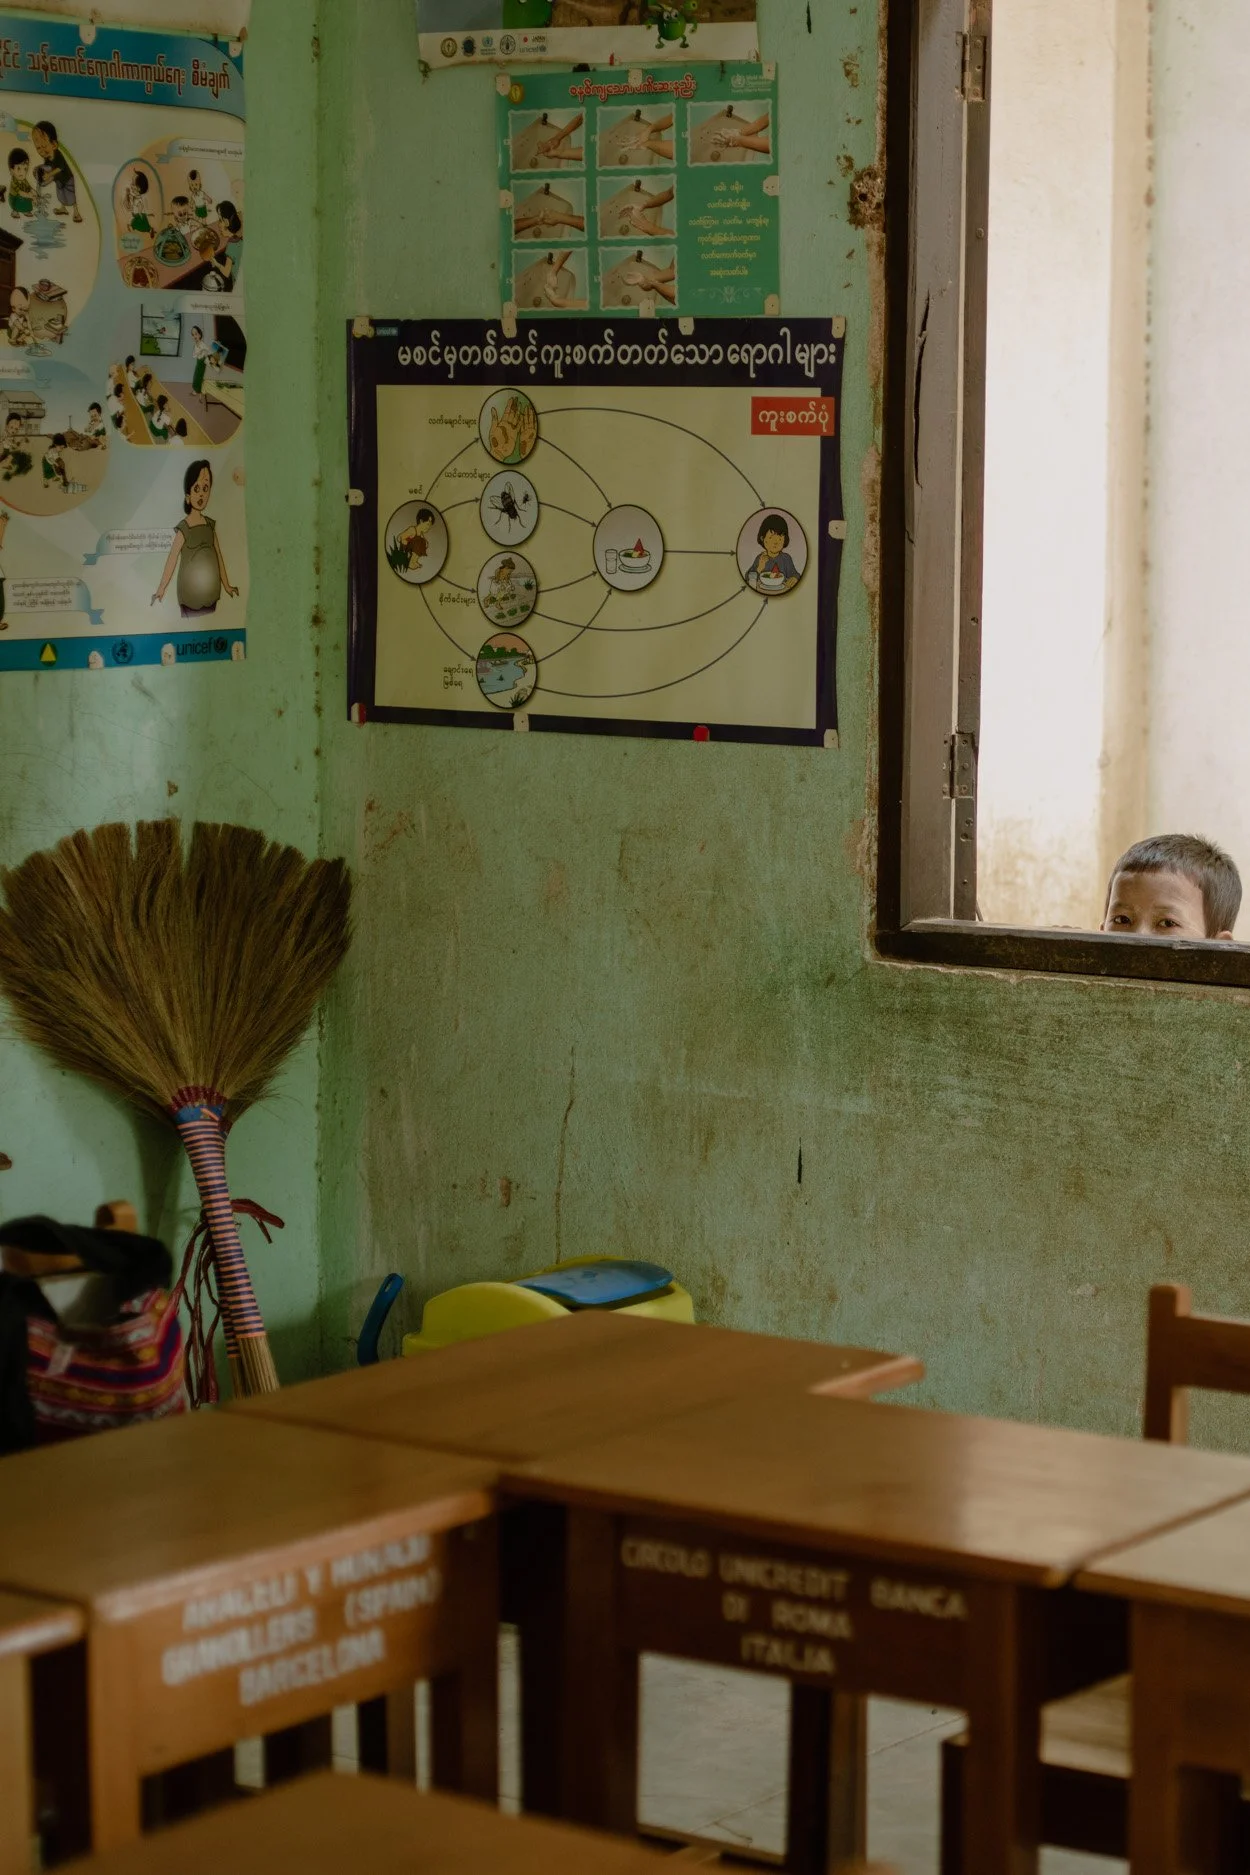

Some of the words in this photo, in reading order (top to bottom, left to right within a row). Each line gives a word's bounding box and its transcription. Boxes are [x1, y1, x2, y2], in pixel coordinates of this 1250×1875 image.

[758, 400, 829, 433] ကူးစက်ပုံ
[176, 637, 213, 656] unicef
[621, 1534, 711, 1579] CIRCOLO
[718, 1552, 852, 1602] UNICREDIT
[870, 1575, 969, 1621] BANCA
[771, 1598, 854, 1640] ROMA
[238, 1626, 386, 1707] BARCELONA
[740, 1631, 837, 1677] ITALIA
